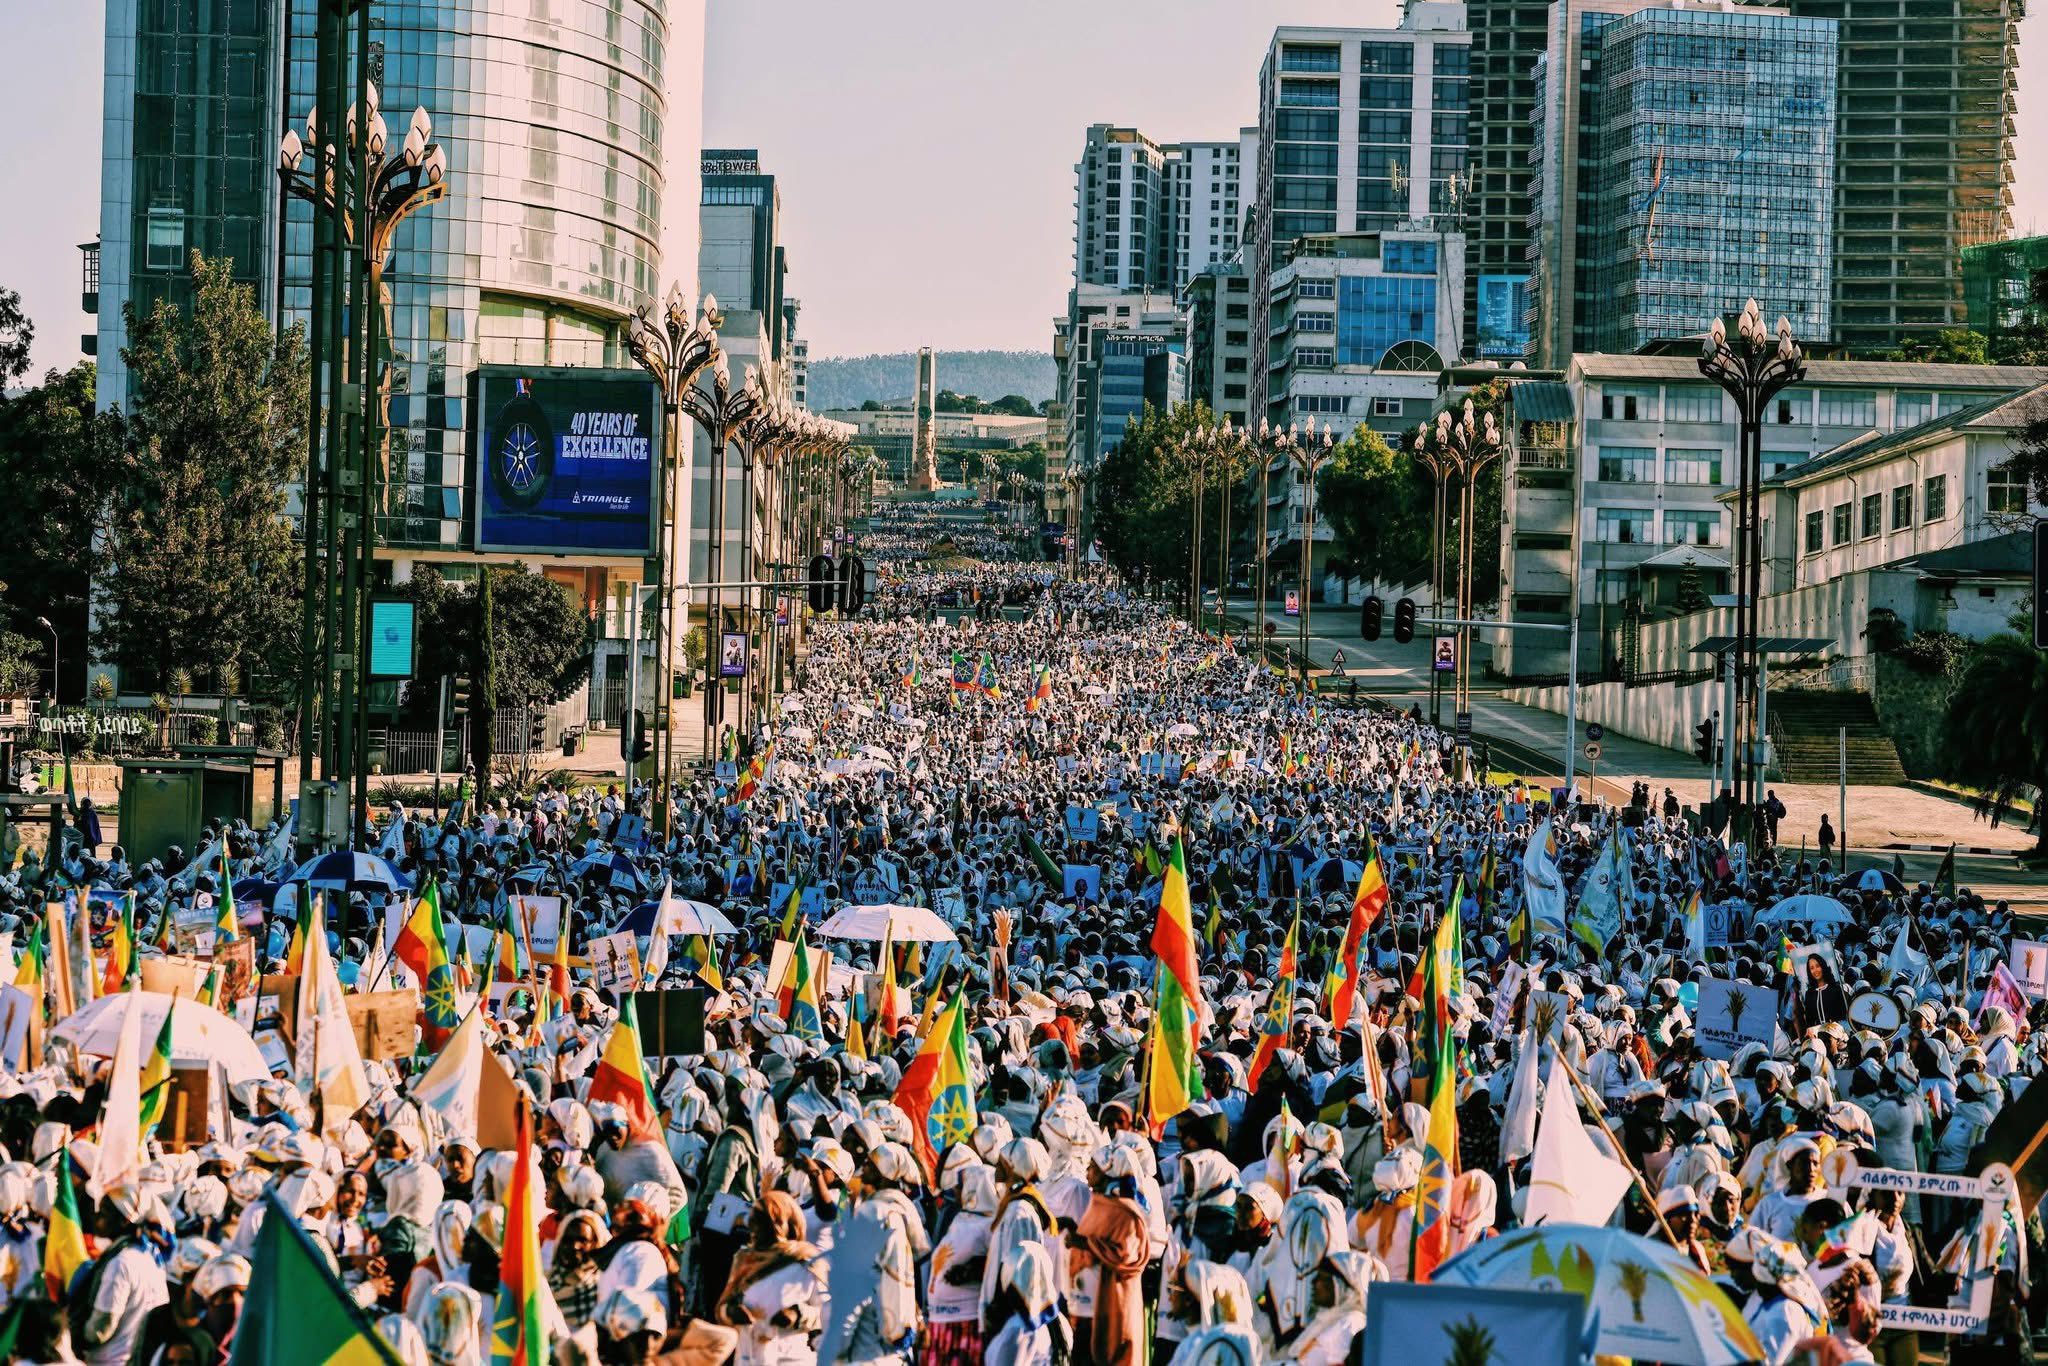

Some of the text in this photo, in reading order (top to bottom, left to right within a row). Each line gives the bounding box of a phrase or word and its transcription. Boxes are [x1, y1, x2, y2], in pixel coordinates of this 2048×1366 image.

[718, 161, 758, 171] TOWER
[570, 412, 638, 437] 40 YEARS OF
[562, 435, 648, 460] EXCELLENCE
[581, 495, 632, 503] TRIANGLE
[1861, 1172, 1913, 1188] ብልፅግናን
[1918, 1178, 1961, 1193] ይምረጡ
[1902, 1310, 1947, 1326] ተምሳሌት
